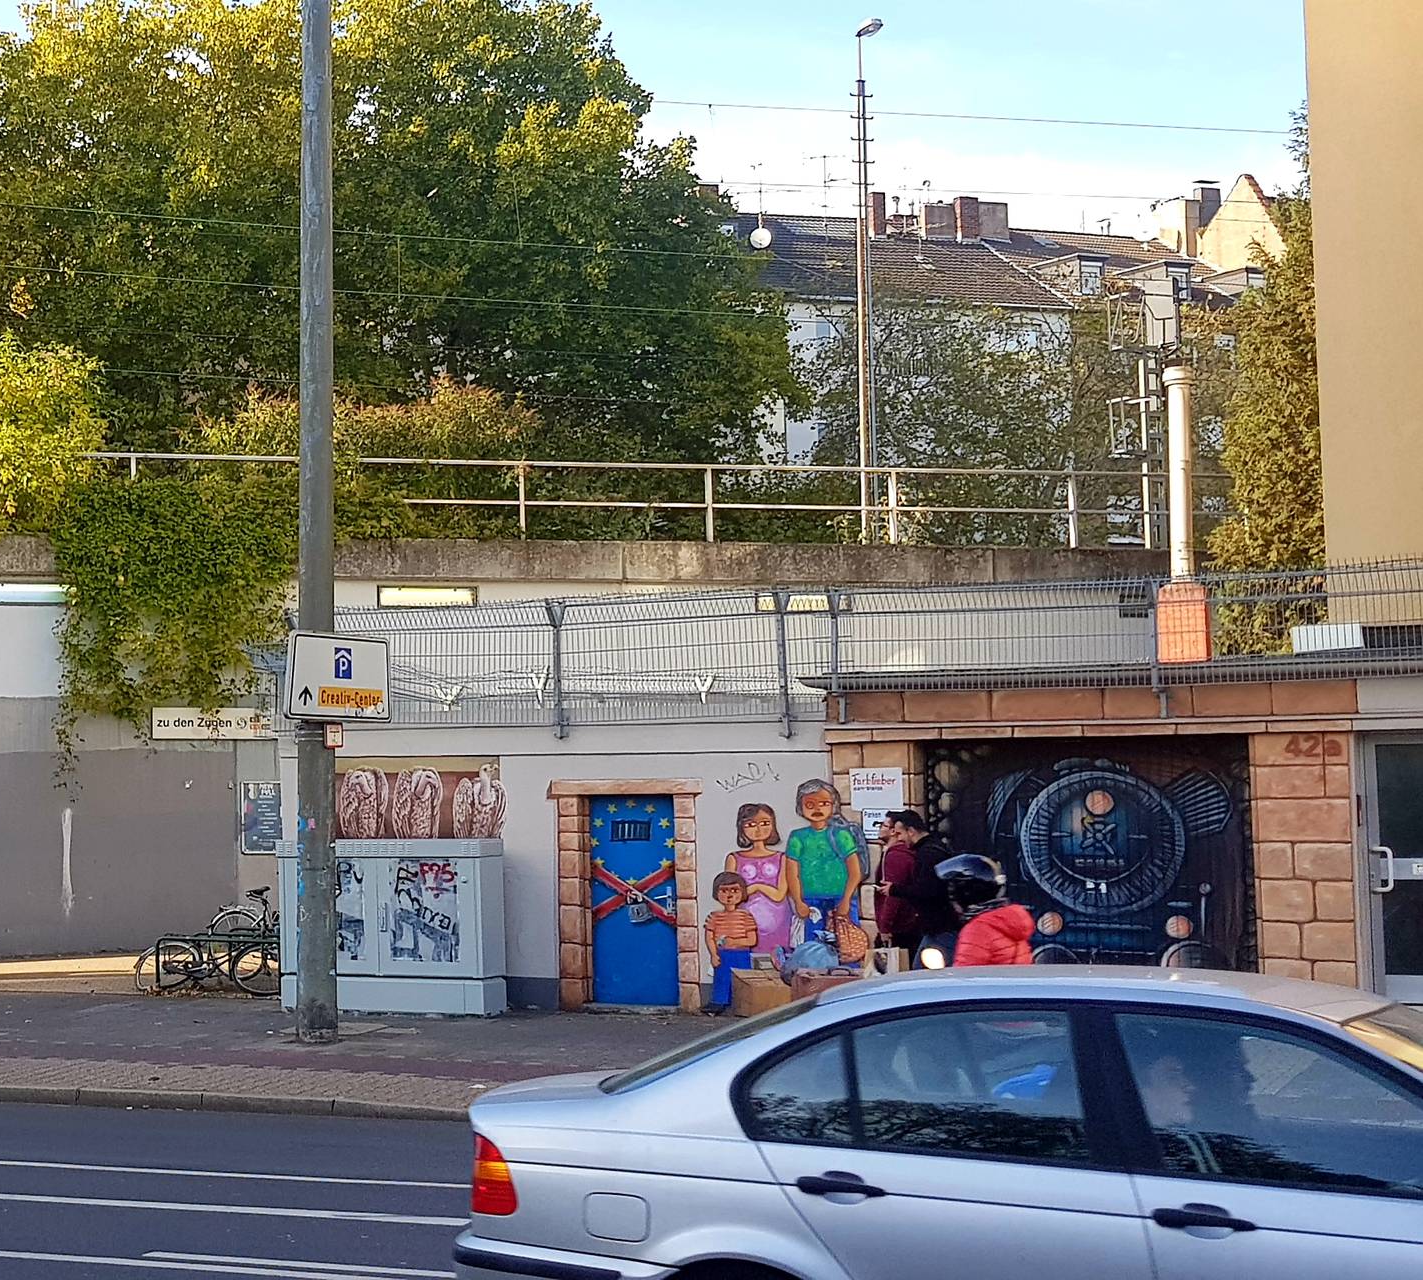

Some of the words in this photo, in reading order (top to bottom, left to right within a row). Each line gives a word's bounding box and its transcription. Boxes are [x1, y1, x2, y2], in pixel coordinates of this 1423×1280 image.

[339, 657, 348, 678] P
[321, 690, 381, 706] Creativ-Center
[156, 718, 170, 728] zu
[173, 717, 194, 728] den
[1285, 735, 1342, 758] 42a
[418, 862, 455, 885] F95
